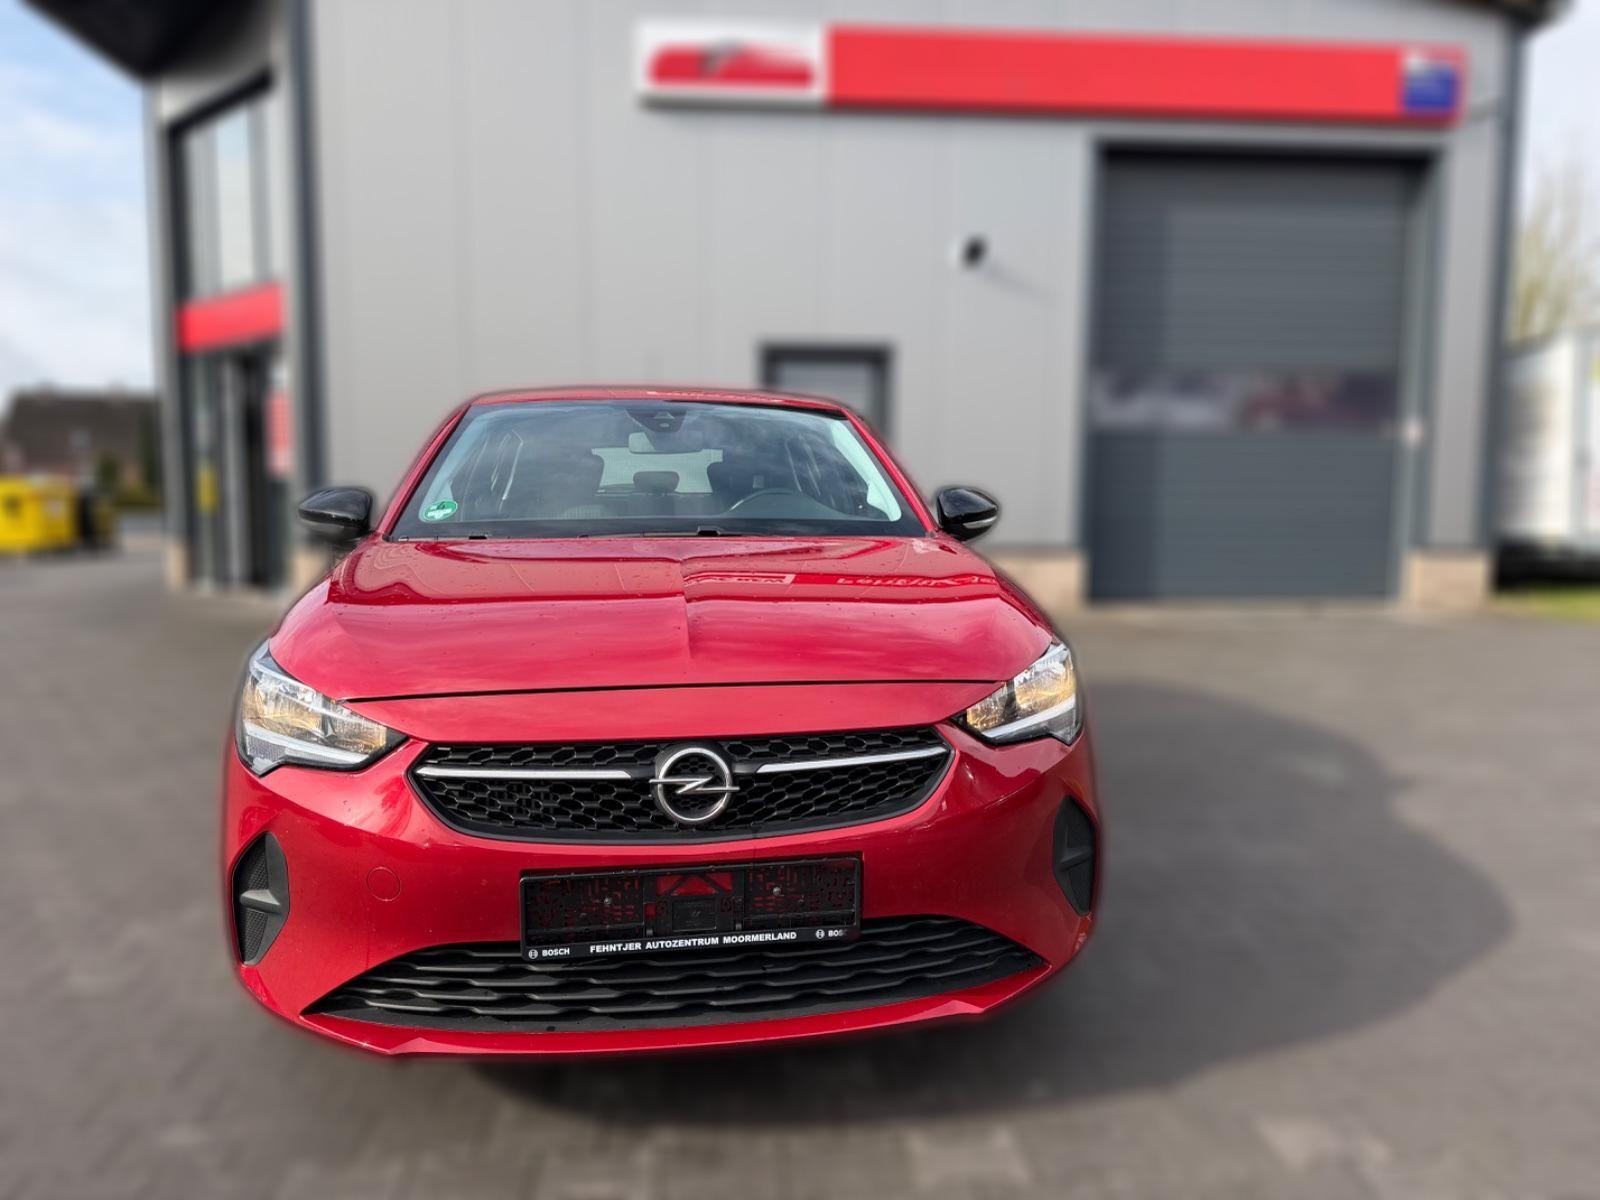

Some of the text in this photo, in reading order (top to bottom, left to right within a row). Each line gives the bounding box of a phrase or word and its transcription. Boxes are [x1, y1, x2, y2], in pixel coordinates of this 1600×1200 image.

[590, 931, 798, 953] FEHNTJER AUTOZENTRUM MOORMERLAND
[542, 948, 570, 957] BOSCH
